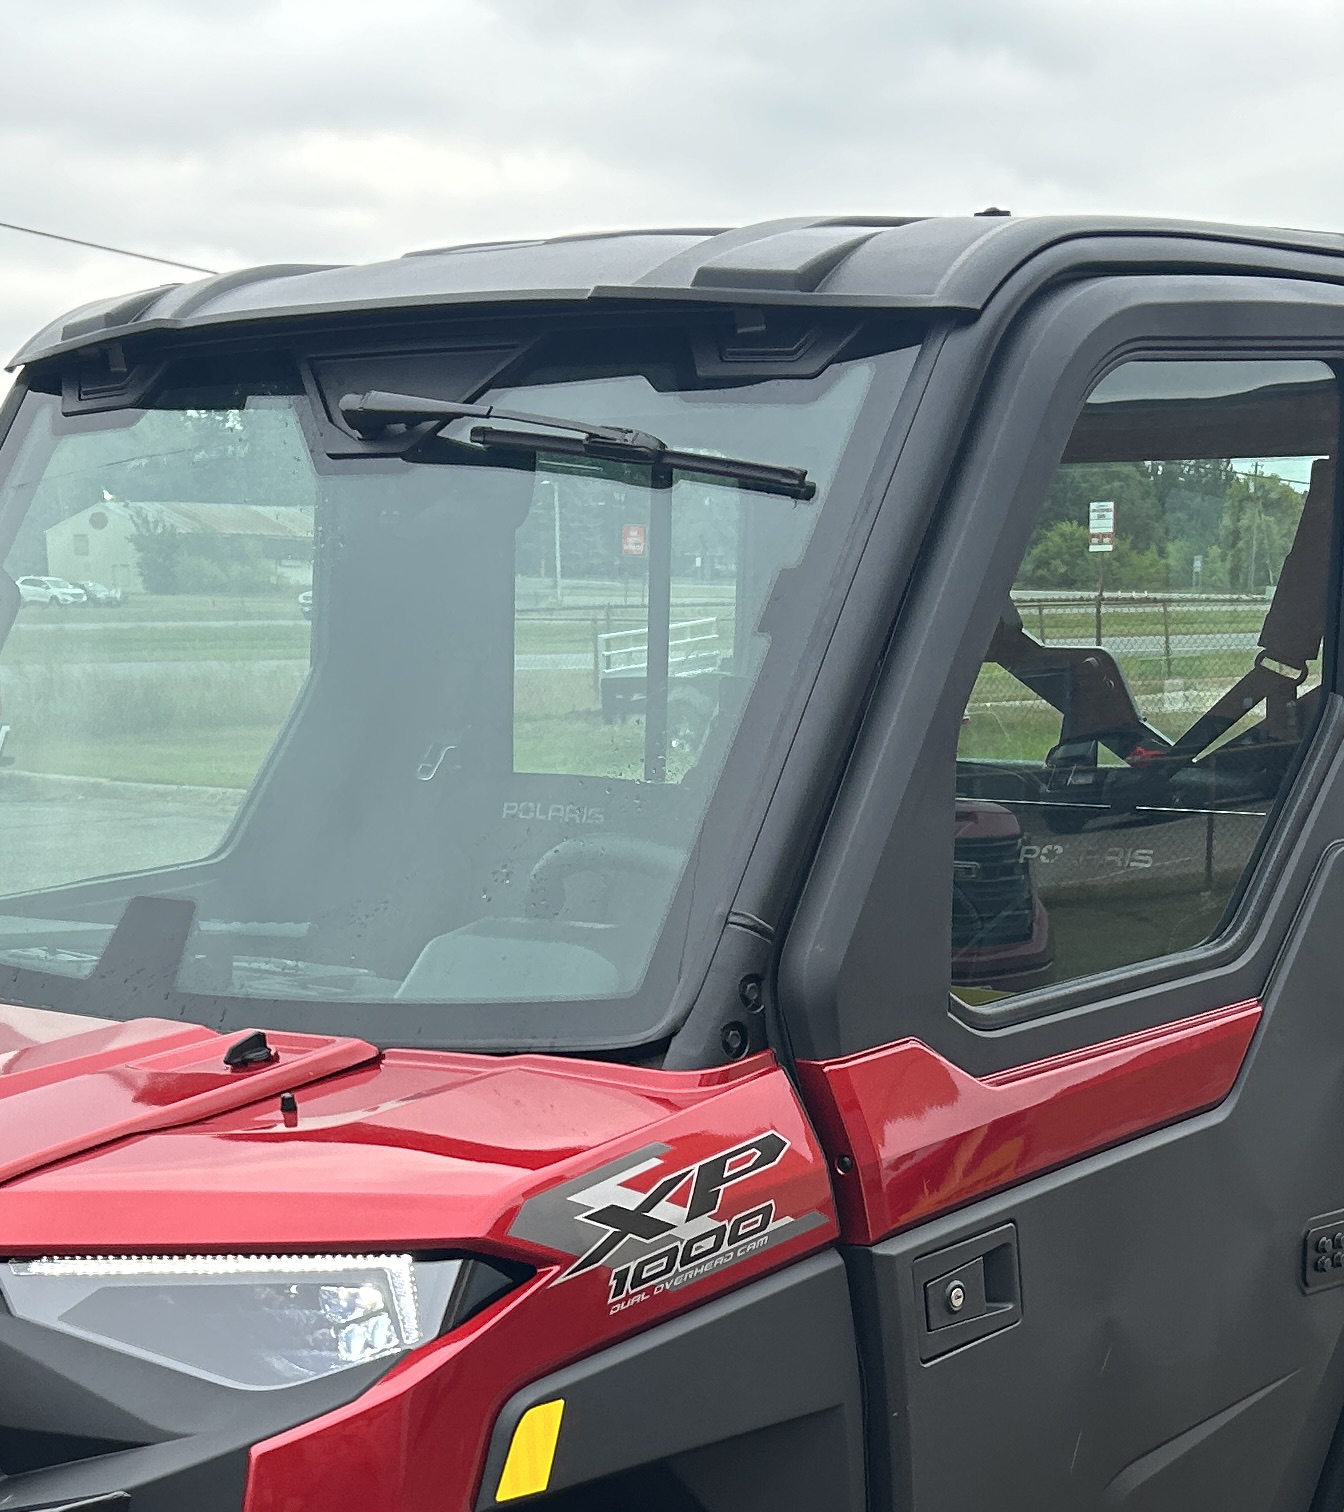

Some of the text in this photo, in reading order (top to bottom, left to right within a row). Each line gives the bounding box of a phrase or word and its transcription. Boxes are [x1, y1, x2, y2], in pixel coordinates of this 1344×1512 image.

[502, 802, 605, 824] POLARIS
[547, 1129, 791, 1290] XP
[607, 1199, 776, 1304] 1000
[609, 1235, 769, 1316] DUAL OVERHEAD CAM
